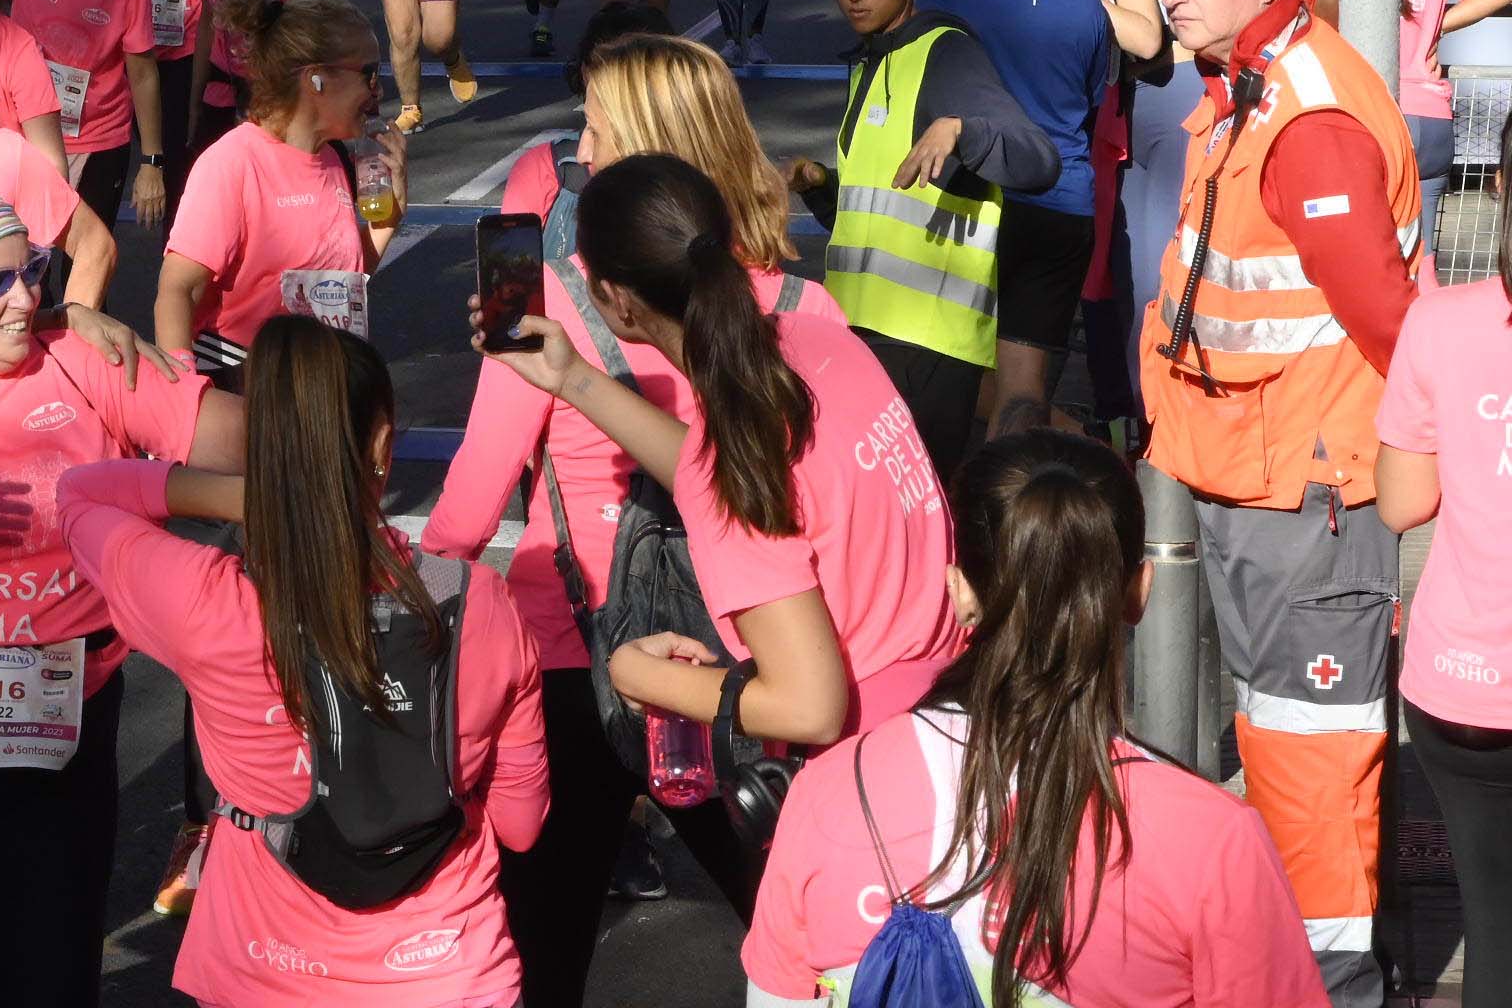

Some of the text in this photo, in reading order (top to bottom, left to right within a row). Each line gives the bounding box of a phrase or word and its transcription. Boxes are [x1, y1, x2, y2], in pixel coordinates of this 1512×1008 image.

[884, 444, 912, 487] DE
[897, 456, 935, 519] MUJ
[42, 653, 73, 663] SUMA
[1434, 655, 1500, 686] OYSHO
[6, 726, 39, 736] MUJER
[43, 727, 64, 737] 2023
[15, 744, 67, 758] Santander
[248, 940, 329, 977] OYSHO
